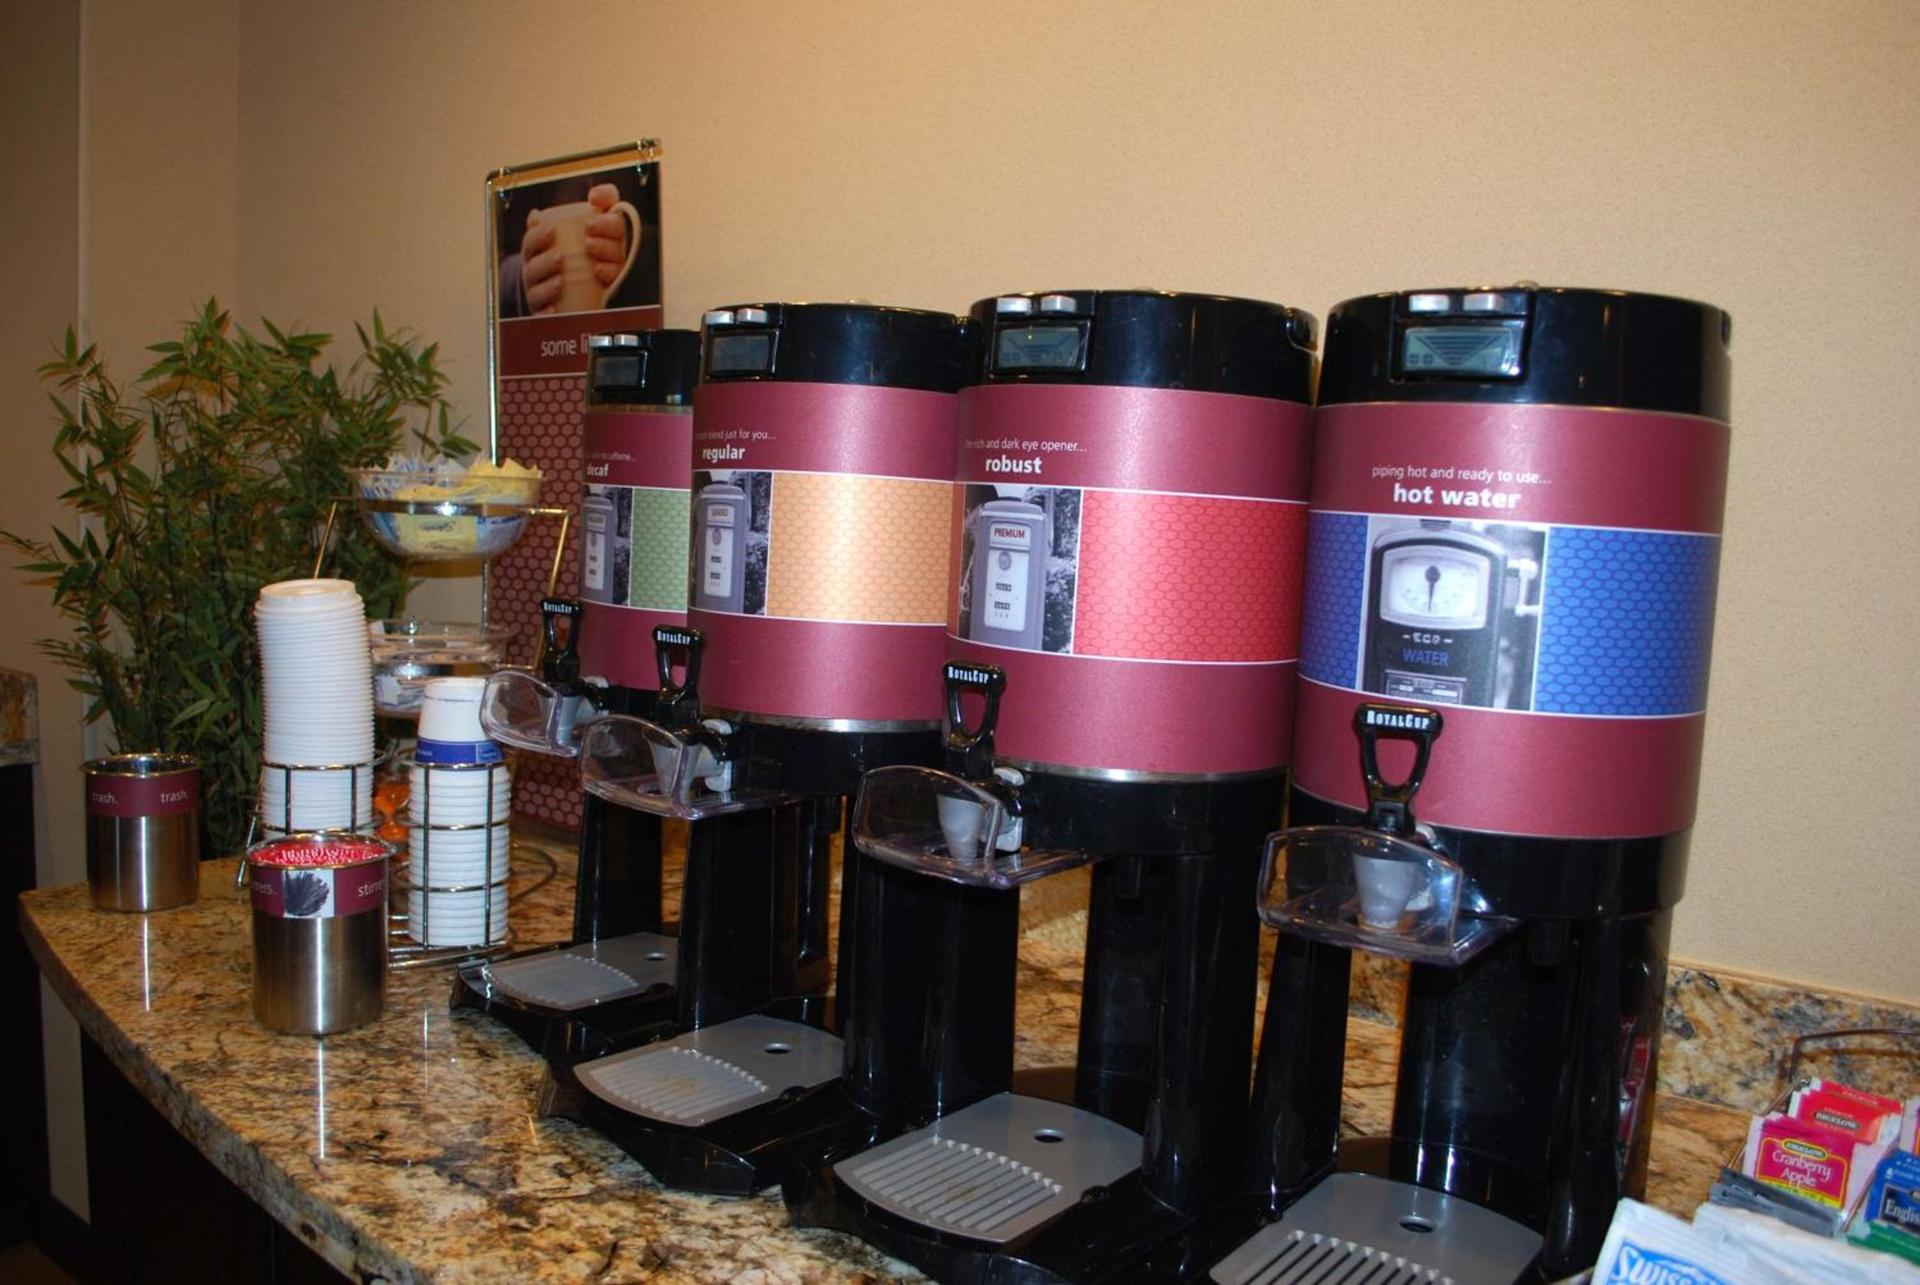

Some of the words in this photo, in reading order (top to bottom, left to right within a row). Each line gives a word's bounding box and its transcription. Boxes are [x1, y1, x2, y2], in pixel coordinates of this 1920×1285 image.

[541, 339, 577, 356] some
[739, 428, 750, 440] for
[702, 444, 746, 463] regular
[986, 438, 1000, 449] and
[1001, 438, 1020, 449] dark
[1022, 440, 1039, 452] eye
[985, 455, 1042, 473] robust
[1407, 465, 1427, 478] hot
[1430, 467, 1454, 479] and
[1457, 468, 1494, 484] ready
[1497, 470, 1513, 482] to
[1393, 483, 1433, 503] hot
[1441, 488, 1522, 509] water
[994, 527, 1025, 539] PREMIUM
[1402, 648, 1449, 667] WATER
[1816, 1112, 1858, 1130] BIGELOW
[1772, 1150, 1832, 1182] Cranberry
[1780, 1167, 1817, 1189] Apple
[1884, 1198, 1920, 1222] Englis
